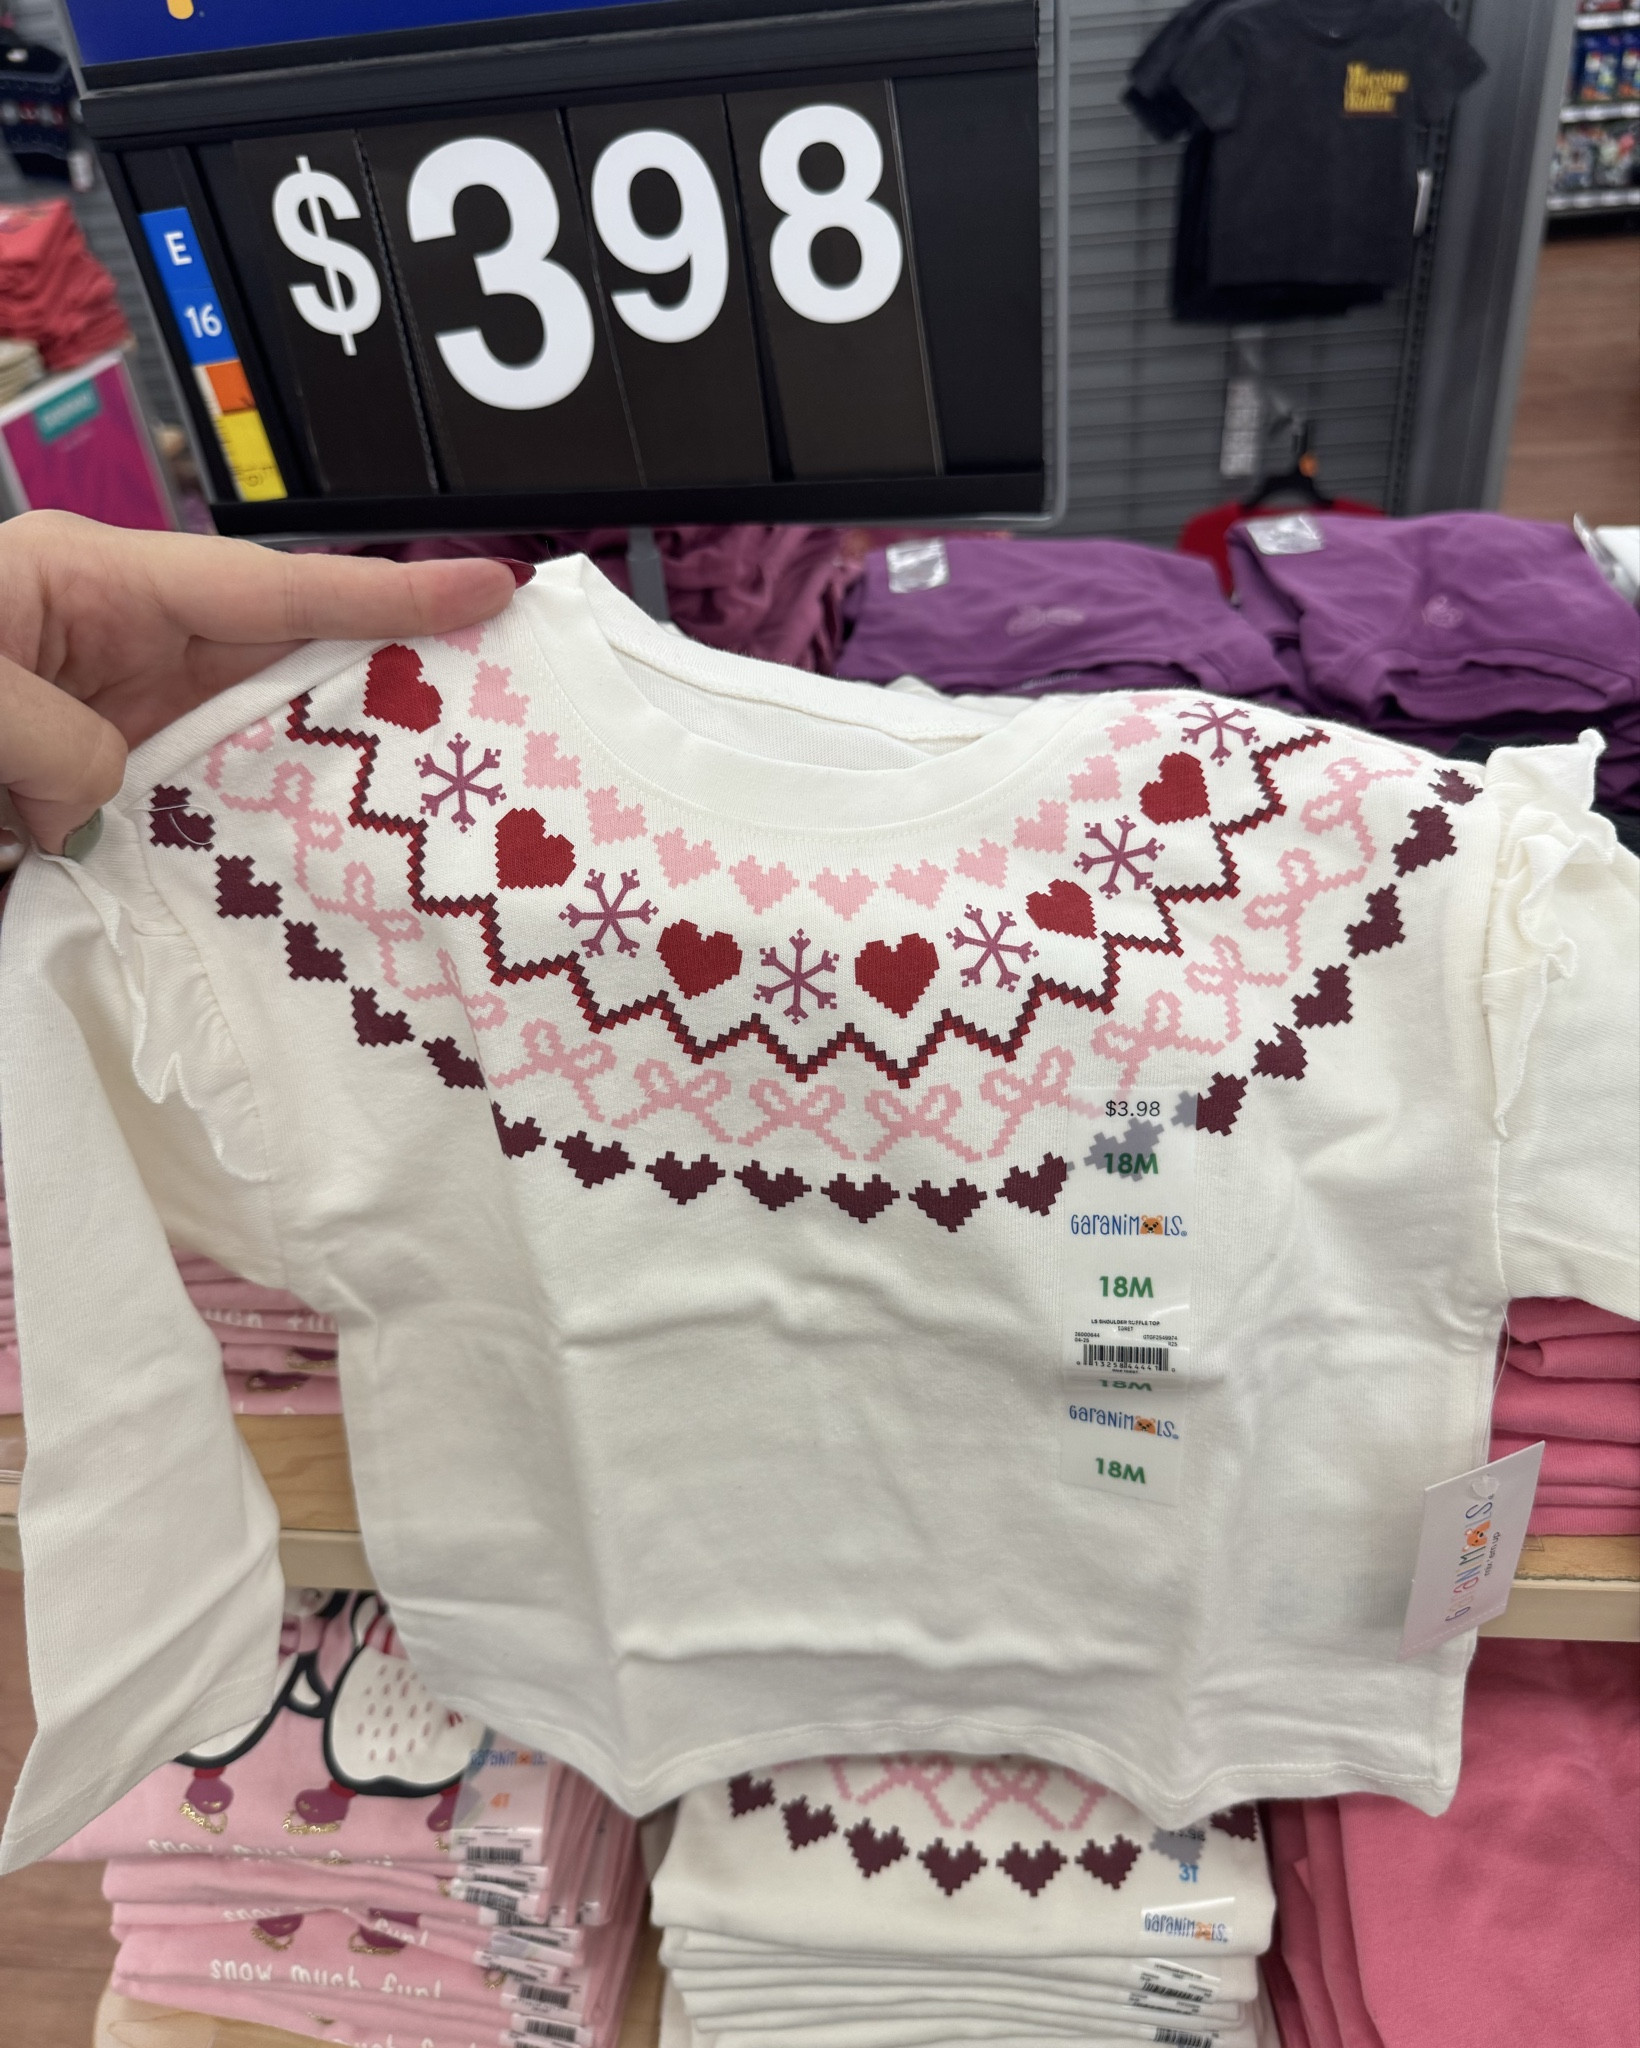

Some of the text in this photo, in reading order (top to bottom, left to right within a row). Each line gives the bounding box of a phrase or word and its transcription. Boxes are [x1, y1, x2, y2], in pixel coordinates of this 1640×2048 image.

[163, 230, 193, 267] E
[184, 303, 223, 339] 16
[1105, 1100, 1160, 1117] $3.98
[1104, 1152, 1159, 1175] 18M
[1099, 1275, 1154, 1298] 18M
[1099, 1379, 1153, 1392] 18M
[1095, 1457, 1146, 1484] 18M
[1179, 1862, 1200, 1883] 3T
[209, 1958, 442, 1998] snow much fun!
